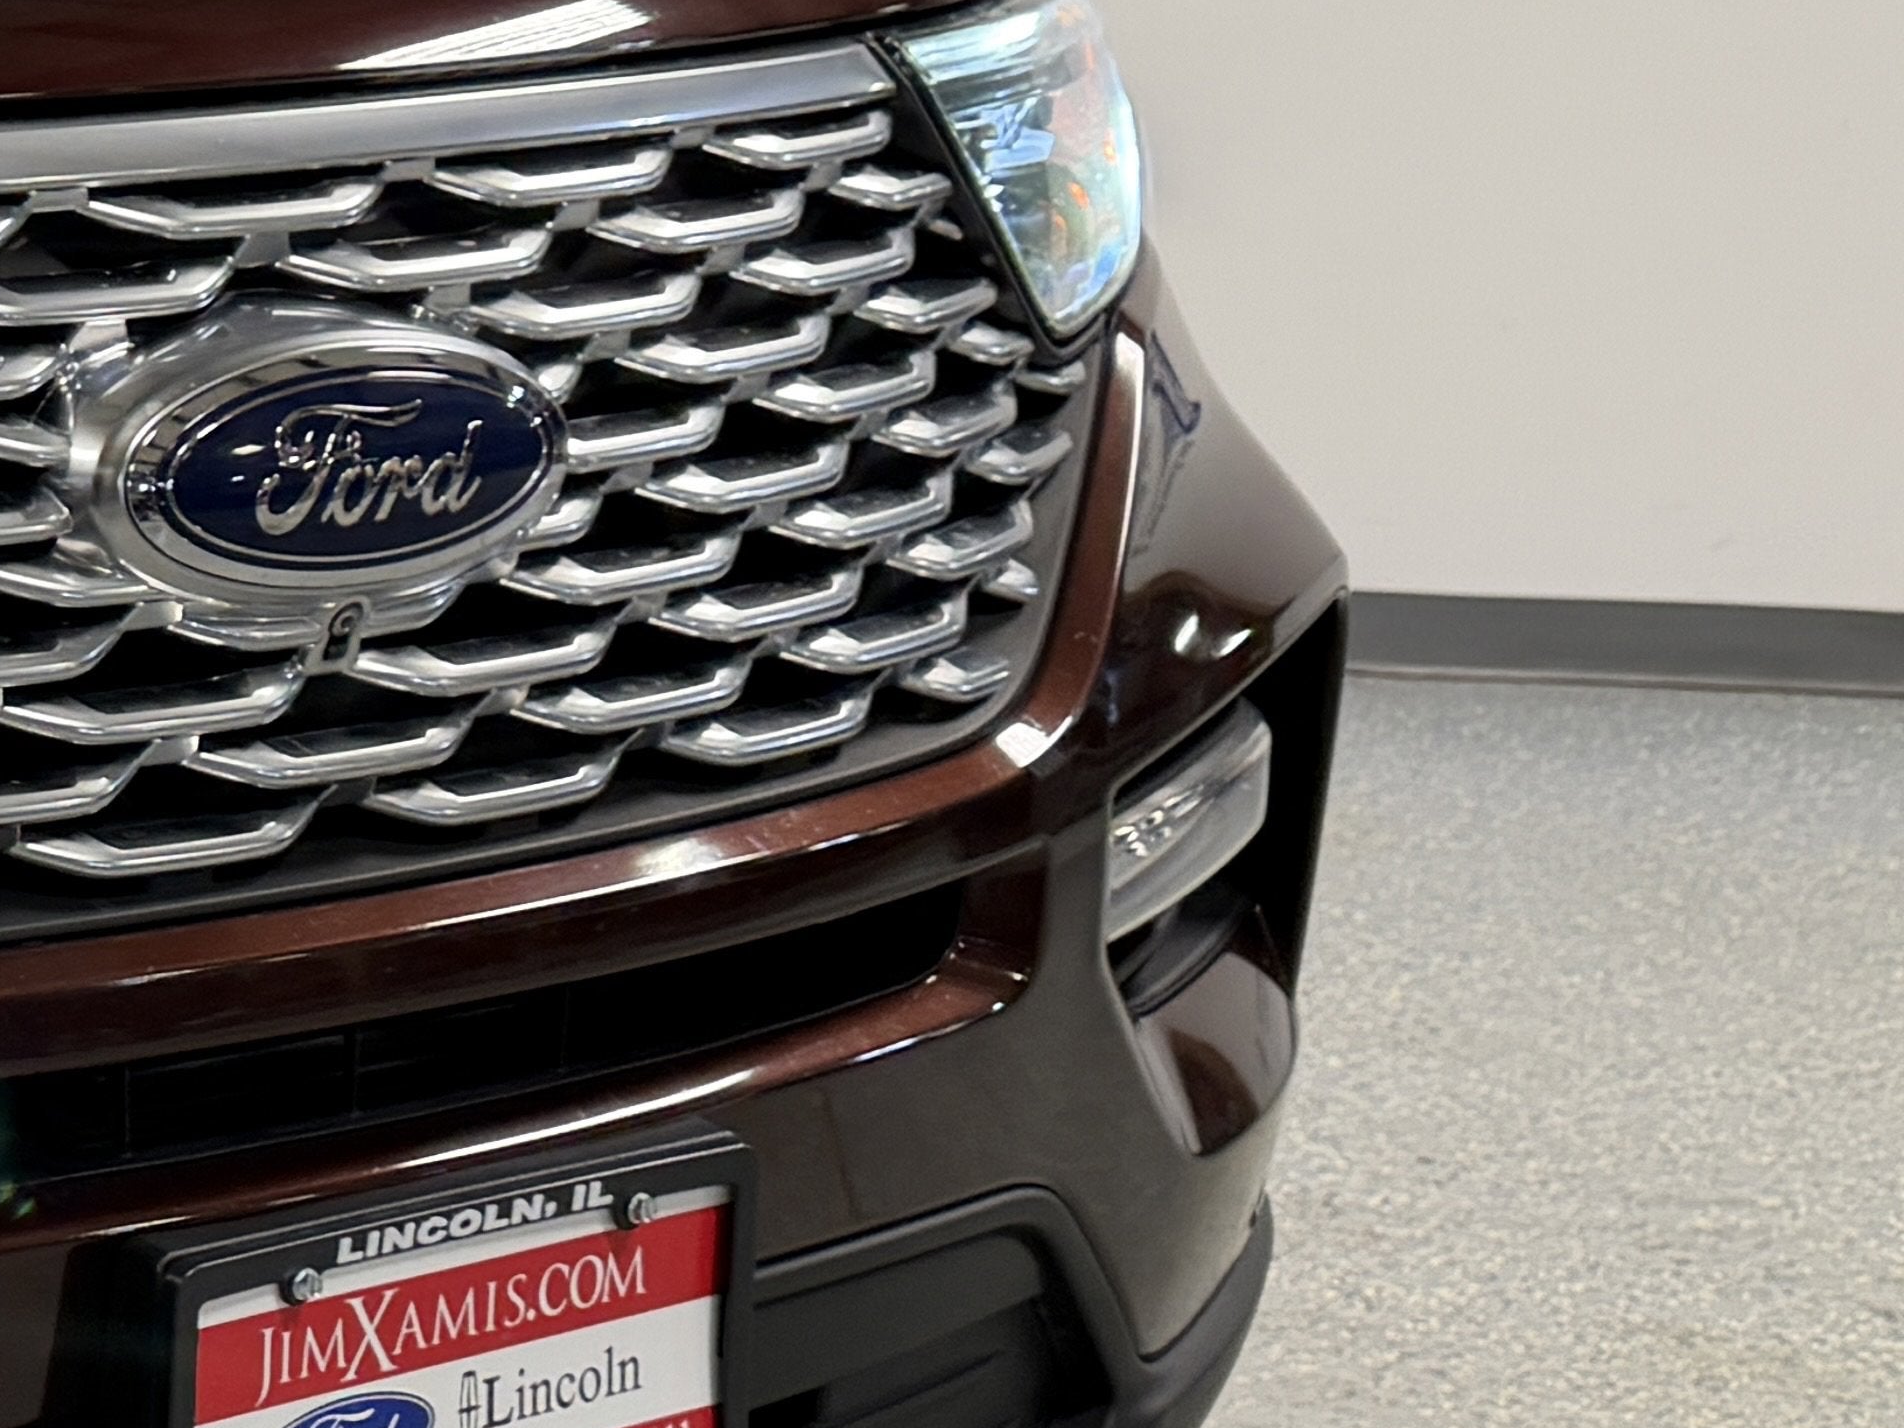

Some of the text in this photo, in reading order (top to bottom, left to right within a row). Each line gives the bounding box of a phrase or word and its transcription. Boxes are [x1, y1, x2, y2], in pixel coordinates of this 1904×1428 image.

[255, 398, 484, 536] Ford
[336, 1180, 614, 1264] LINCOLN, IL
[255, 1245, 646, 1407] JIMXAMIS.COM
